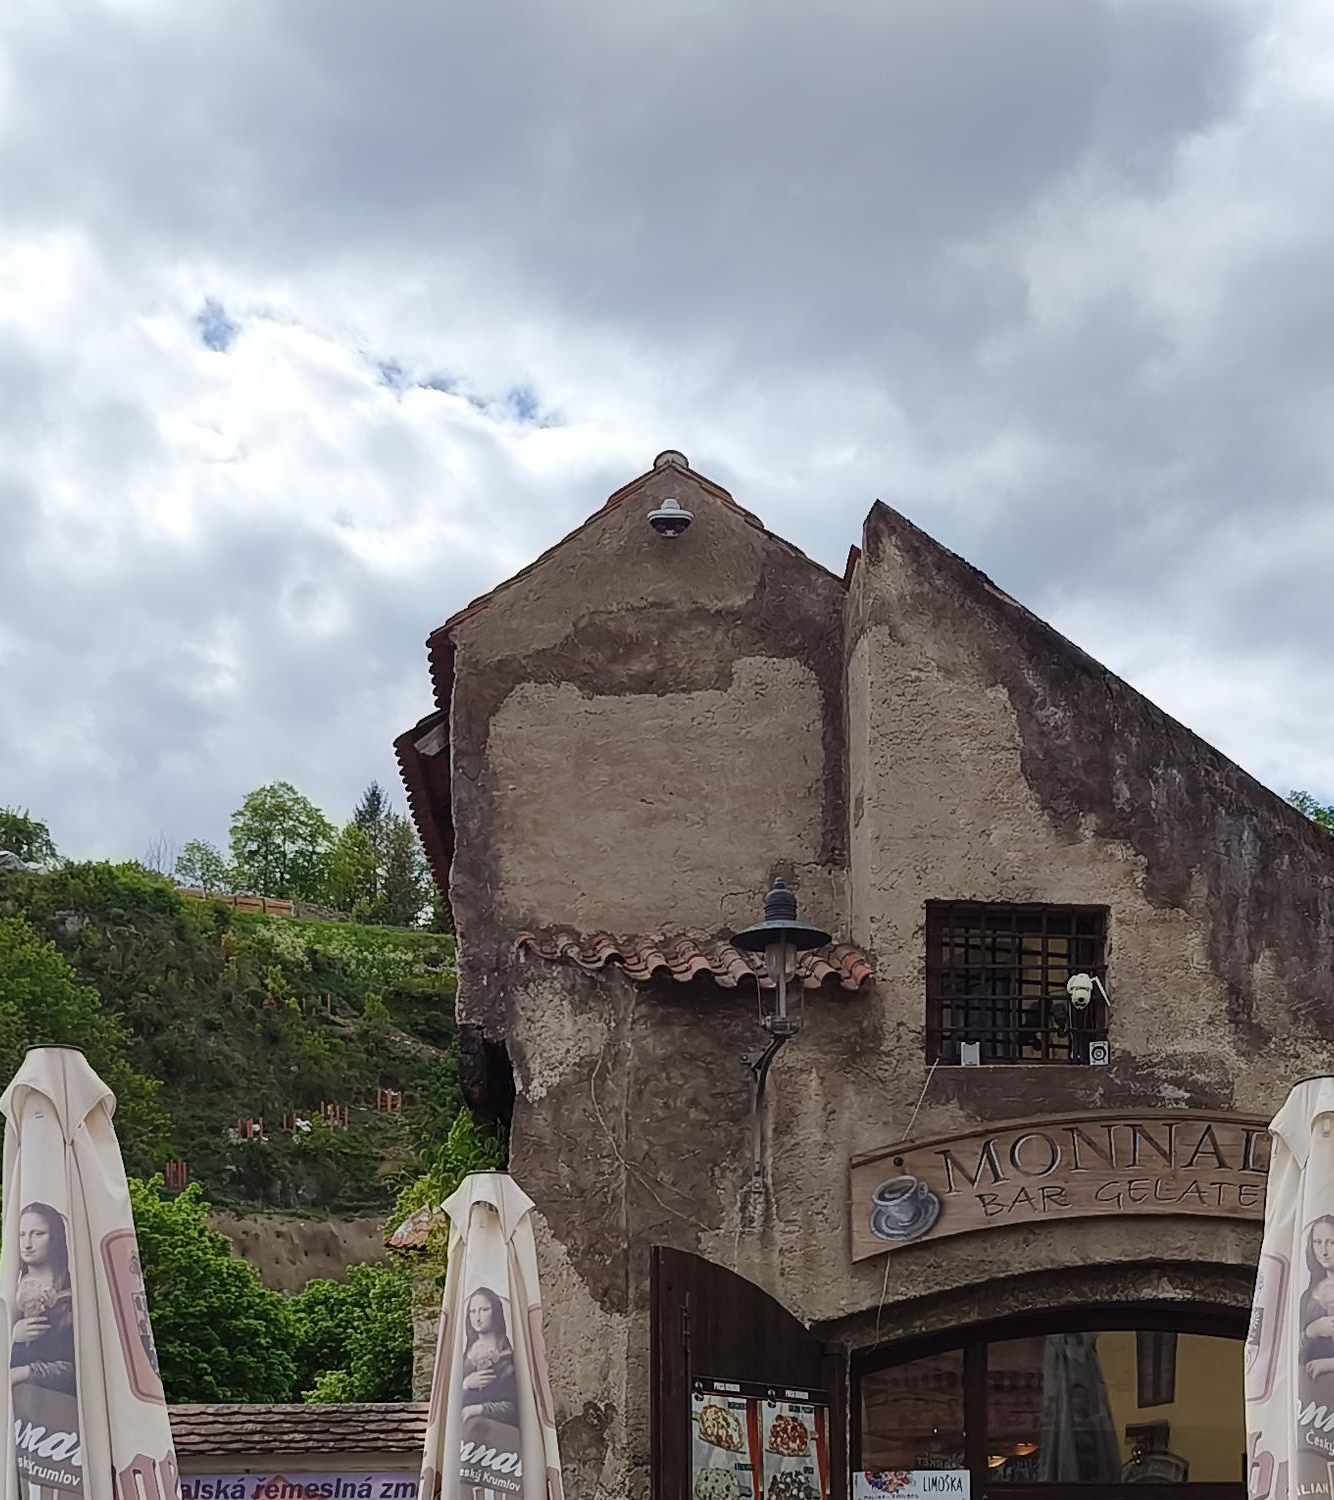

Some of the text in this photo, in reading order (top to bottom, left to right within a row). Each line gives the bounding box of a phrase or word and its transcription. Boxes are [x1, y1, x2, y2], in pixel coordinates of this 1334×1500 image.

[975, 1178, 1260, 1216] BAR GELATE
[180, 1478, 245, 1500] alská
[251, 1477, 372, 1500] řemeslná
[459, 1468, 521, 1492] eský Krumlov
[923, 1474, 963, 1492] LIMOŠKA
